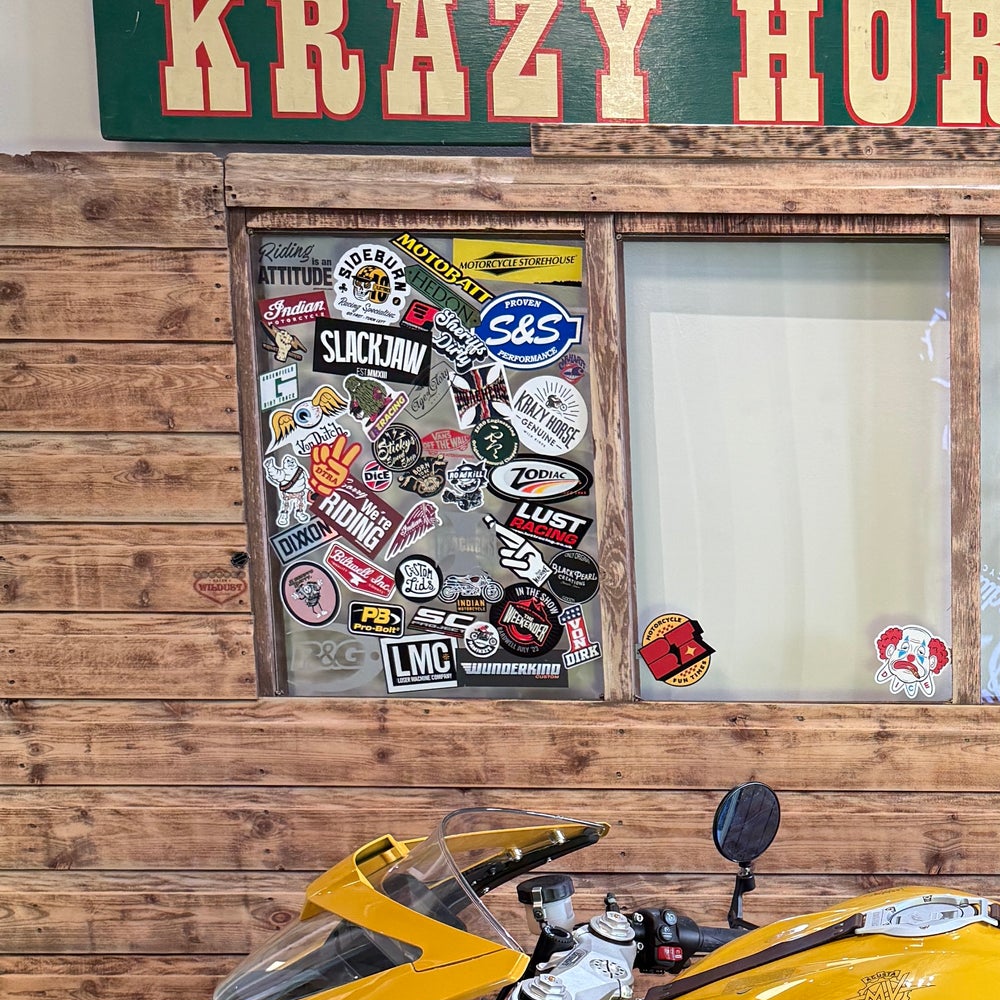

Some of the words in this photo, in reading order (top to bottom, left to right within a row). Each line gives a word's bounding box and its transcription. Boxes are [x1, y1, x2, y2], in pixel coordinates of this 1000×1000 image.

[160, 0, 650, 122] KRAZY
[259, 242, 314, 262] Riding
[312, 258, 319, 266] is
[459, 256, 518, 270] MOTORCYCLE
[518, 254, 576, 267] STOREHOUSE
[258, 266, 332, 286] ATTITUDE
[338, 248, 406, 292] SIDEBURN
[397, 233, 494, 303] MOTOBATT
[412, 271, 474, 323] HEDON
[504, 298, 542, 309] PROVEN
[263, 300, 326, 321] Indian
[268, 312, 326, 327] MOTORCYCLE
[486, 314, 562, 345] S&S
[320, 330, 428, 376] SLACKJAW
[432, 332, 472, 366] Dirty
[497, 346, 558, 363] PERFORMANCE
[514, 390, 550, 424] KRAZY
[548, 414, 581, 450] HORSE
[312, 422, 348, 446] Dutch
[436, 440, 450, 450] THE
[521, 418, 556, 448] GENUINE
[316, 466, 339, 485] DTRA
[412, 462, 431, 476] BORN
[510, 466, 568, 491] ZODIAC
[318, 493, 386, 551] RIDING
[360, 497, 392, 531] We're
[516, 502, 586, 533] LUST
[278, 520, 333, 557] DIXXON
[510, 517, 579, 546] RACING
[331, 549, 374, 578] Biltwell
[405, 578, 436, 594] Lids
[557, 574, 586, 586] CREATIONS
[515, 586, 524, 596] IN
[526, 586, 540, 598] THE
[539, 594, 560, 615] SHOW
[361, 606, 391, 624] PB
[411, 620, 465, 634] PROJECT
[414, 608, 475, 627] SC
[502, 604, 548, 643] WEEKENDER
[353, 622, 398, 634] Pro-Bolt
[570, 618, 586, 648] VON
[646, 616, 682, 641] MOTORCYCLE
[392, 640, 451, 678] LMC
[565, 646, 600, 667] DIRK
[461, 662, 562, 676] WUNDERKIND
[690, 660, 708, 682] TIMES
